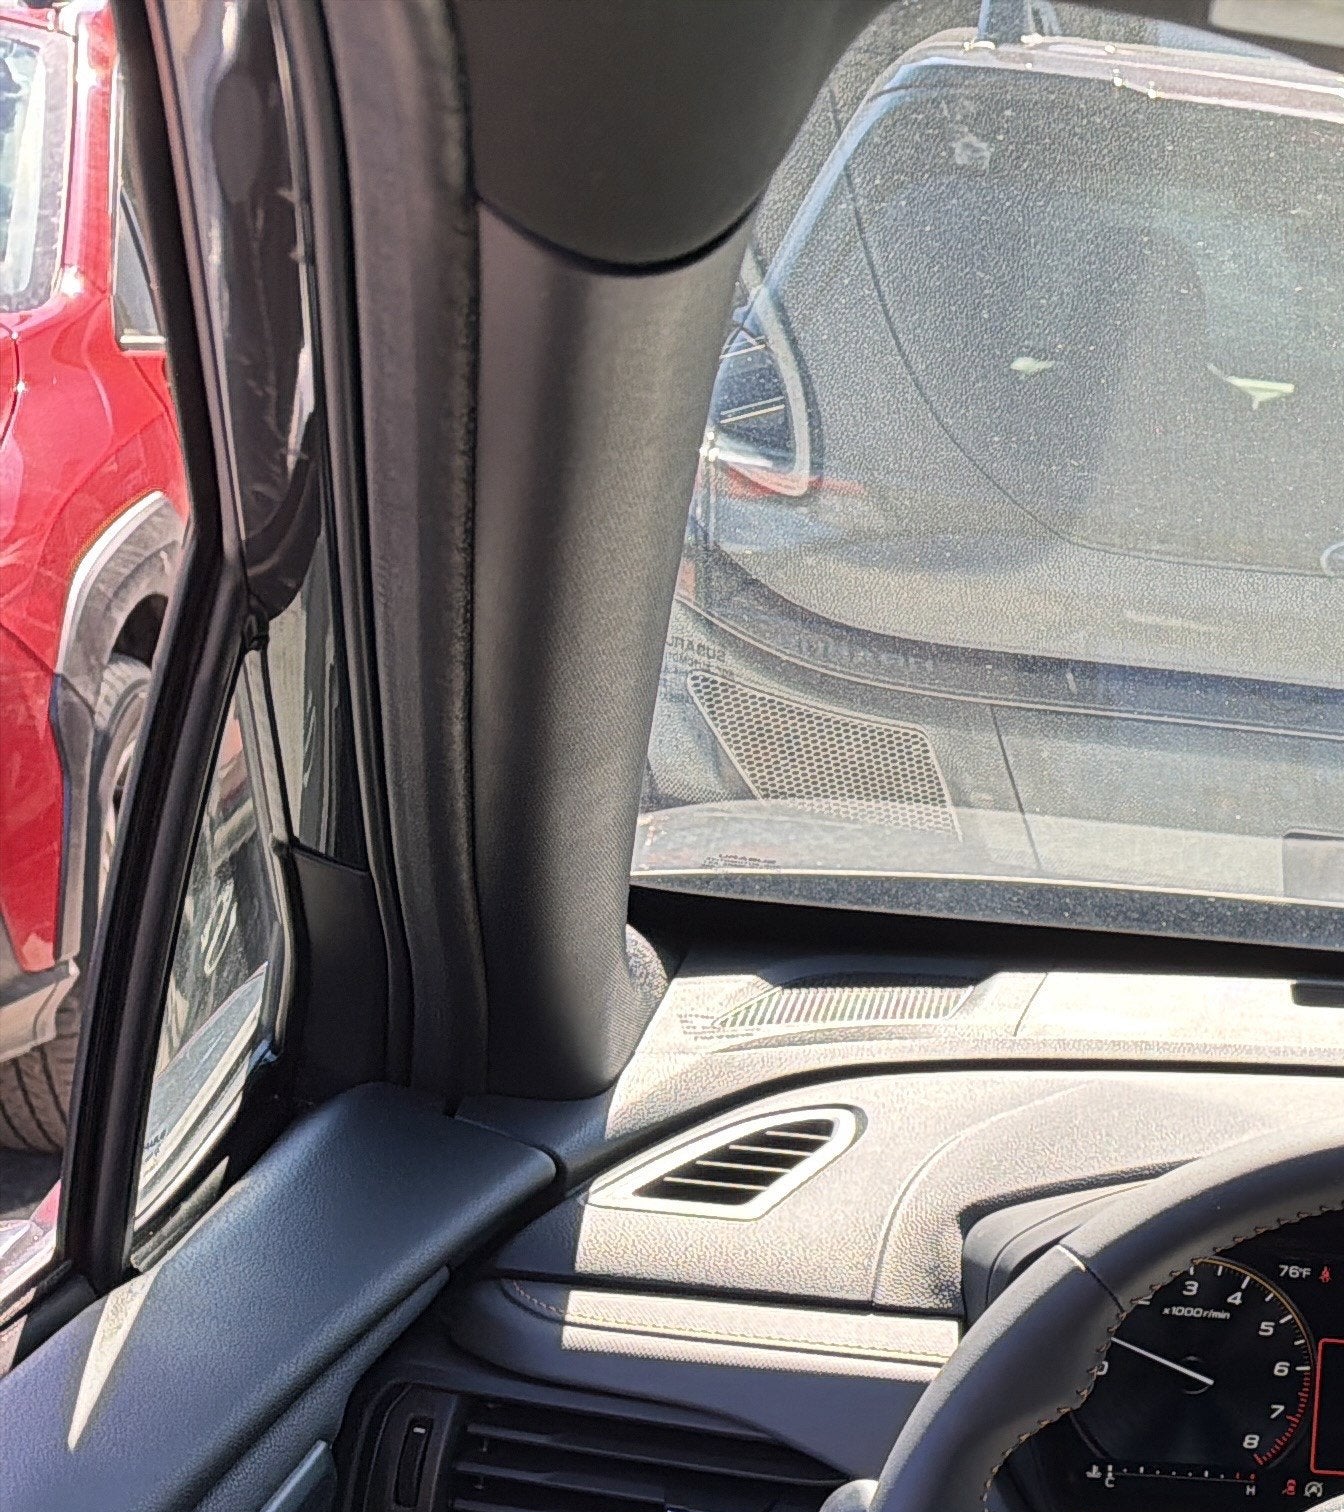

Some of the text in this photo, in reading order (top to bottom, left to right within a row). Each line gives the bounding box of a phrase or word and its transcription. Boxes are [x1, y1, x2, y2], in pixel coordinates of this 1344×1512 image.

[1182, 1279, 1199, 1296] 3
[1226, 1291, 1243, 1306] 4
[1258, 1321, 1275, 1336] 5
[1273, 1361, 1290, 1377] 6
[1269, 1404, 1285, 1419] 7
[1242, 1434, 1260, 1449] 8
[1245, 1485, 1256, 1496] H
